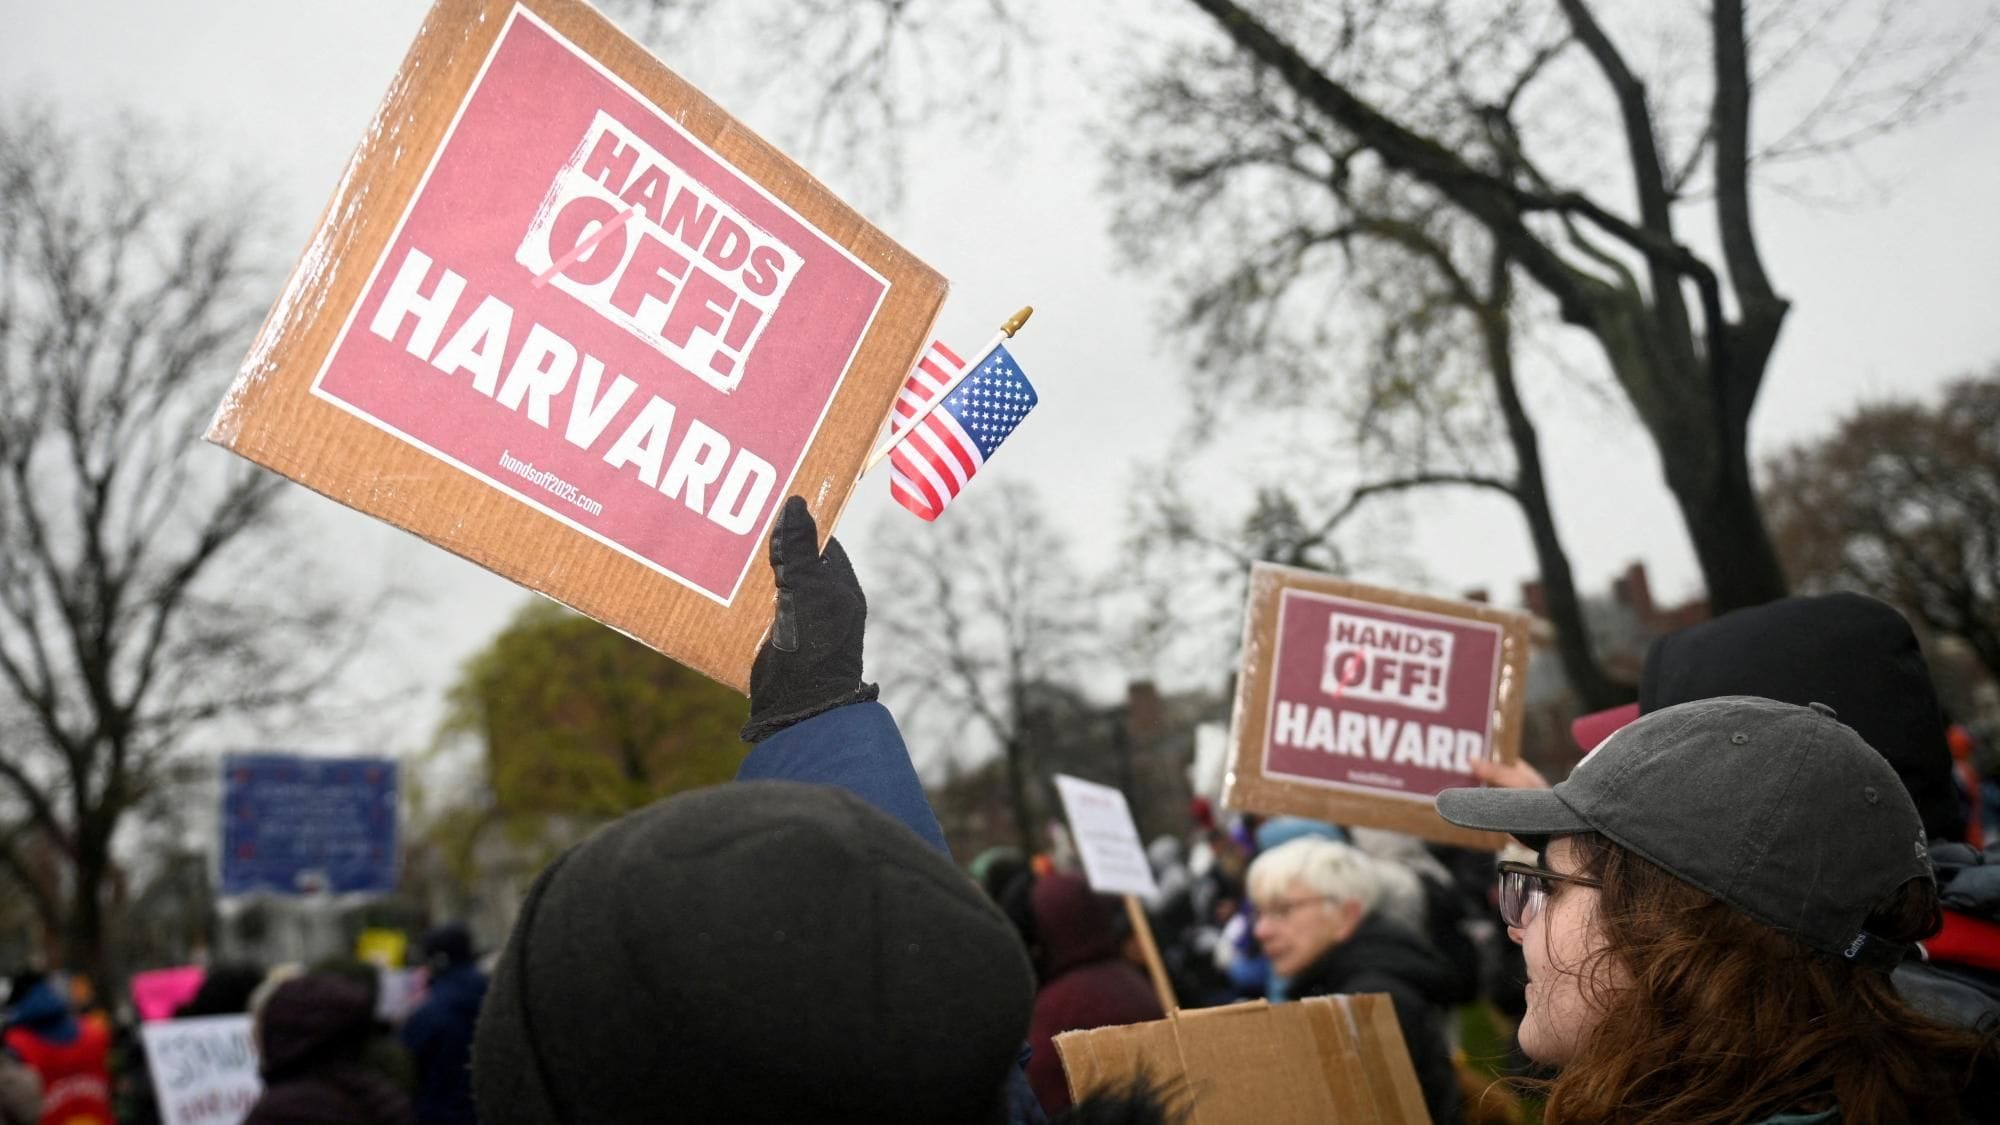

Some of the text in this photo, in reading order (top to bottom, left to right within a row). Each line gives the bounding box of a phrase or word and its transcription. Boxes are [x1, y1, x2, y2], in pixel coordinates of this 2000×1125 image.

[581, 128, 786, 297] HANDS
[547, 195, 764, 378] OFF!
[369, 245, 778, 537] HARVARD
[498, 448, 604, 518] handsoff2025.com
[1332, 650, 1442, 700] OFF!
[1336, 620, 1444, 658] HANDS
[1273, 701, 1484, 774] HARVARD
